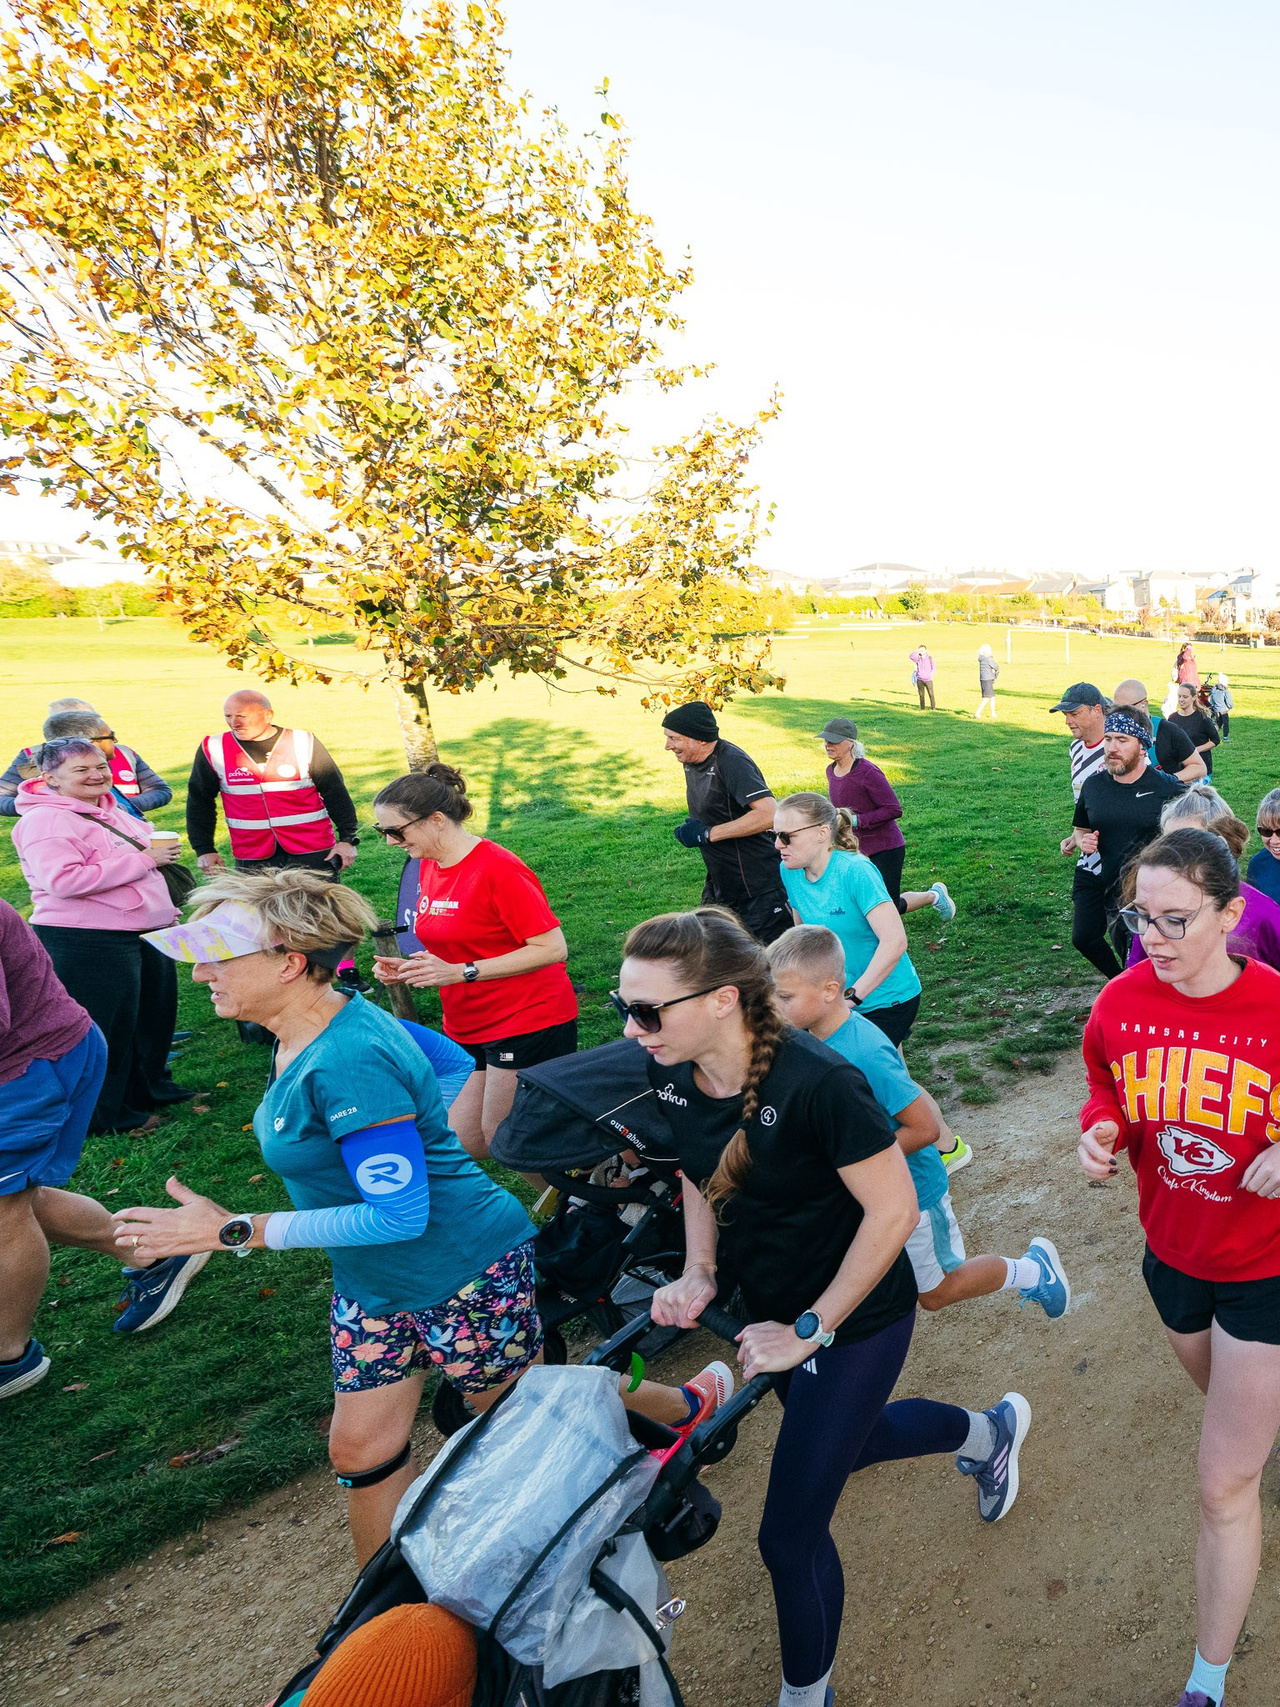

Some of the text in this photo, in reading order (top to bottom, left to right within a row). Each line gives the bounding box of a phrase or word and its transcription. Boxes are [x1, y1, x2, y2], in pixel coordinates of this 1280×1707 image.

[1120, 1022, 1268, 1048] KANSAS CITY
[1172, 1136, 1214, 1168] KC
[1157, 1165, 1233, 1203] Chiefs Kingdom
